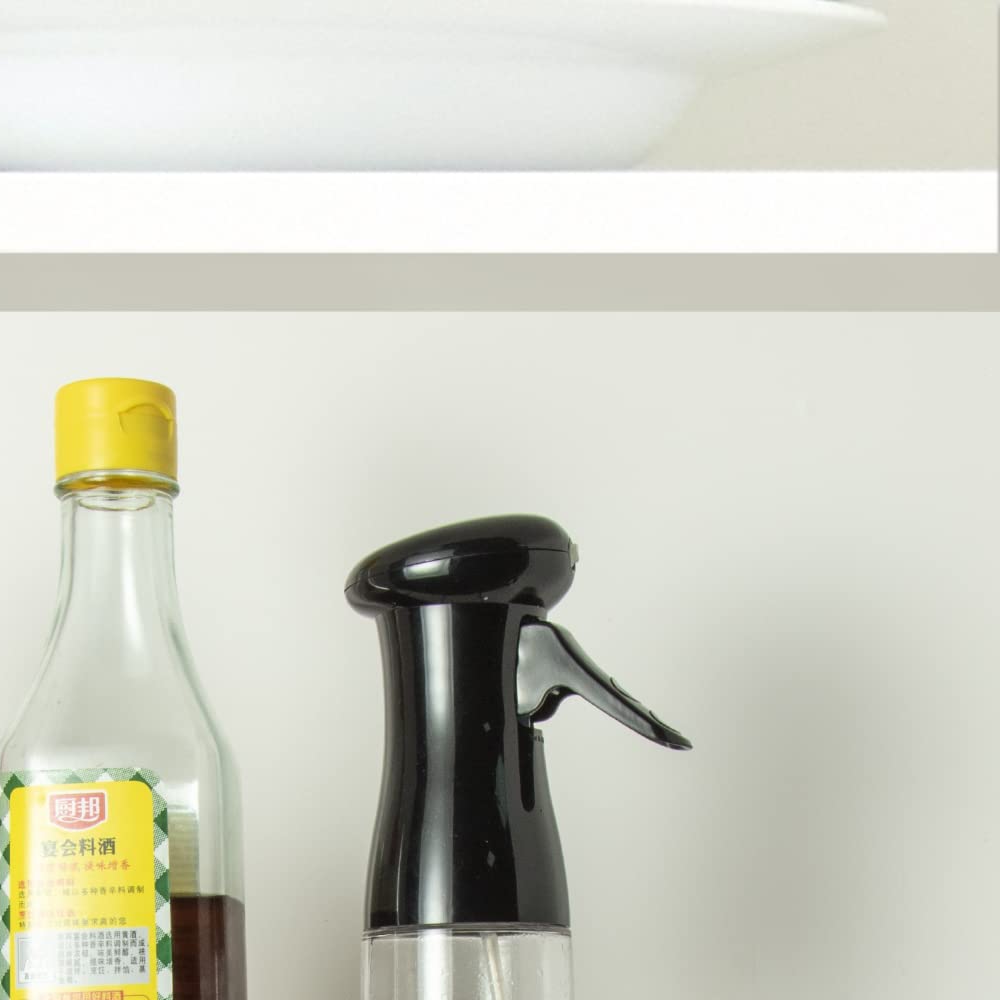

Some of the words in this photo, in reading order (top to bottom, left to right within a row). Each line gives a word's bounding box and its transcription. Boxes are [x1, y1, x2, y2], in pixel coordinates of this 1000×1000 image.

[55, 796, 100, 819] 厨邦
[40, 837, 116, 857] 宴会料酒
